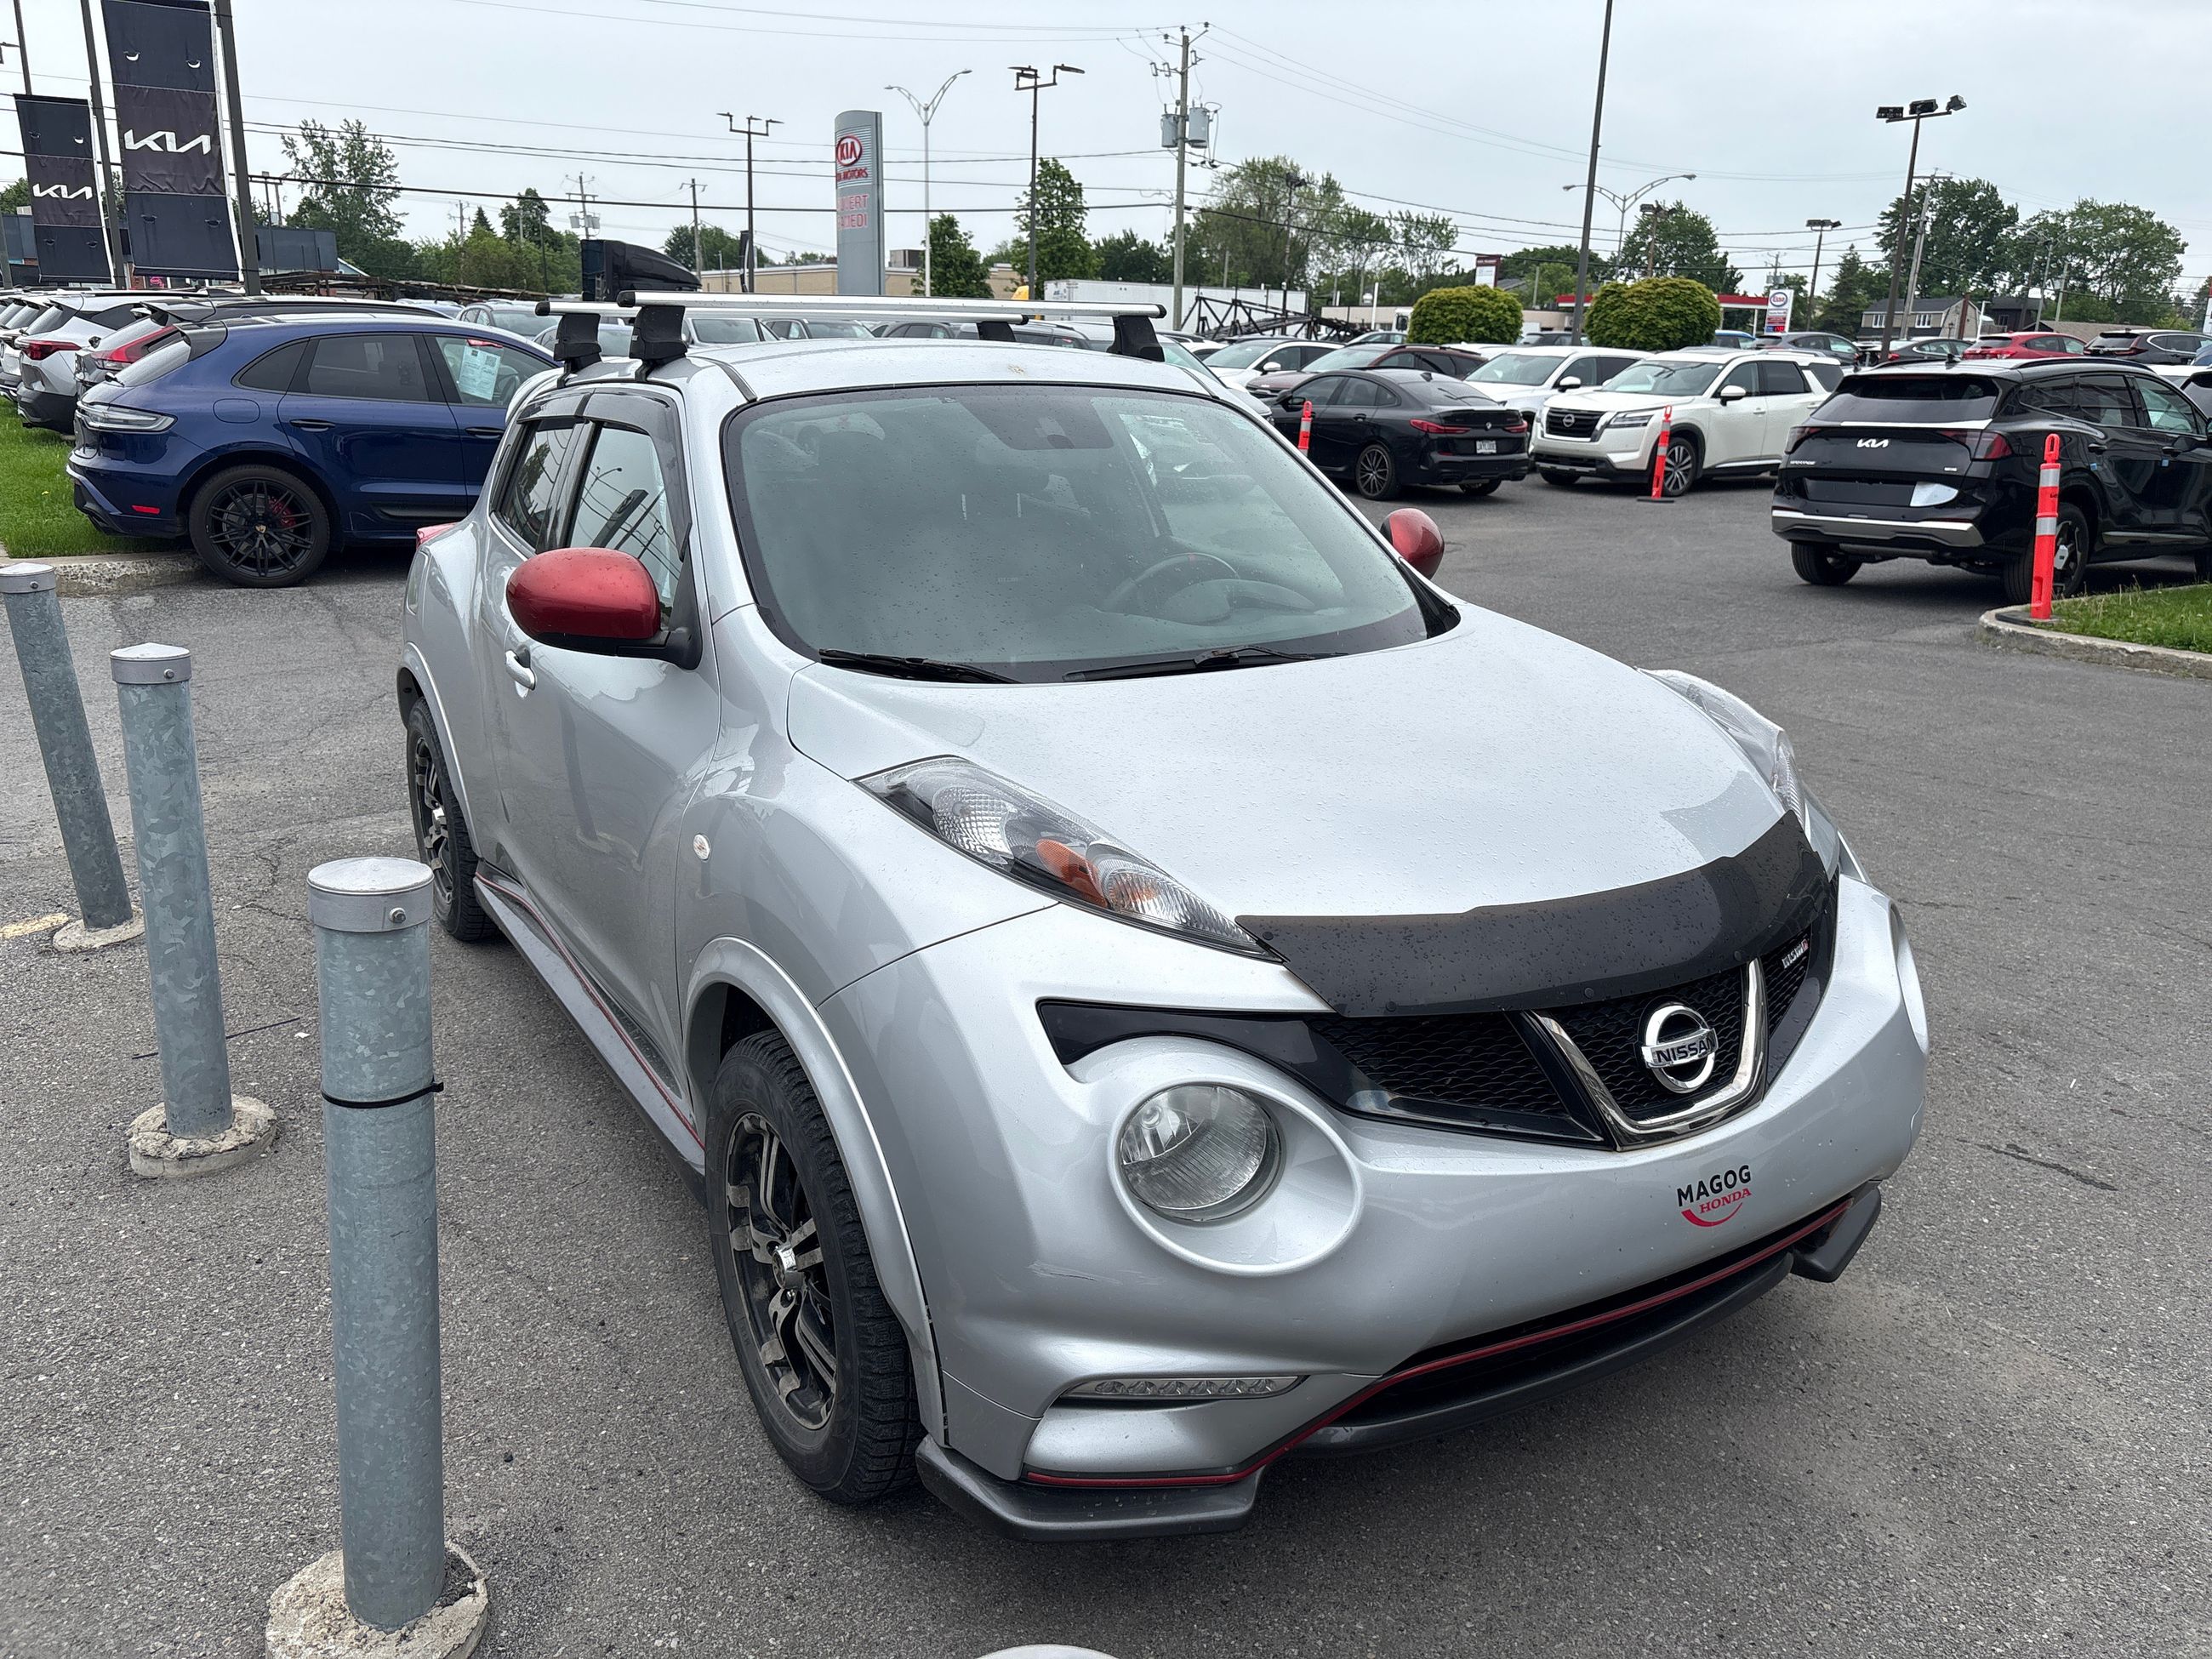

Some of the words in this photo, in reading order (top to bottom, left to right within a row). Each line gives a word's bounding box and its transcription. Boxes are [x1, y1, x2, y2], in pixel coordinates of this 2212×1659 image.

[840, 141, 858, 160] KIA
[1656, 1037, 1716, 1063] NISSAN
[1677, 1165, 1752, 1206] MAGOG
[1699, 1188, 1752, 1214] HONDA
